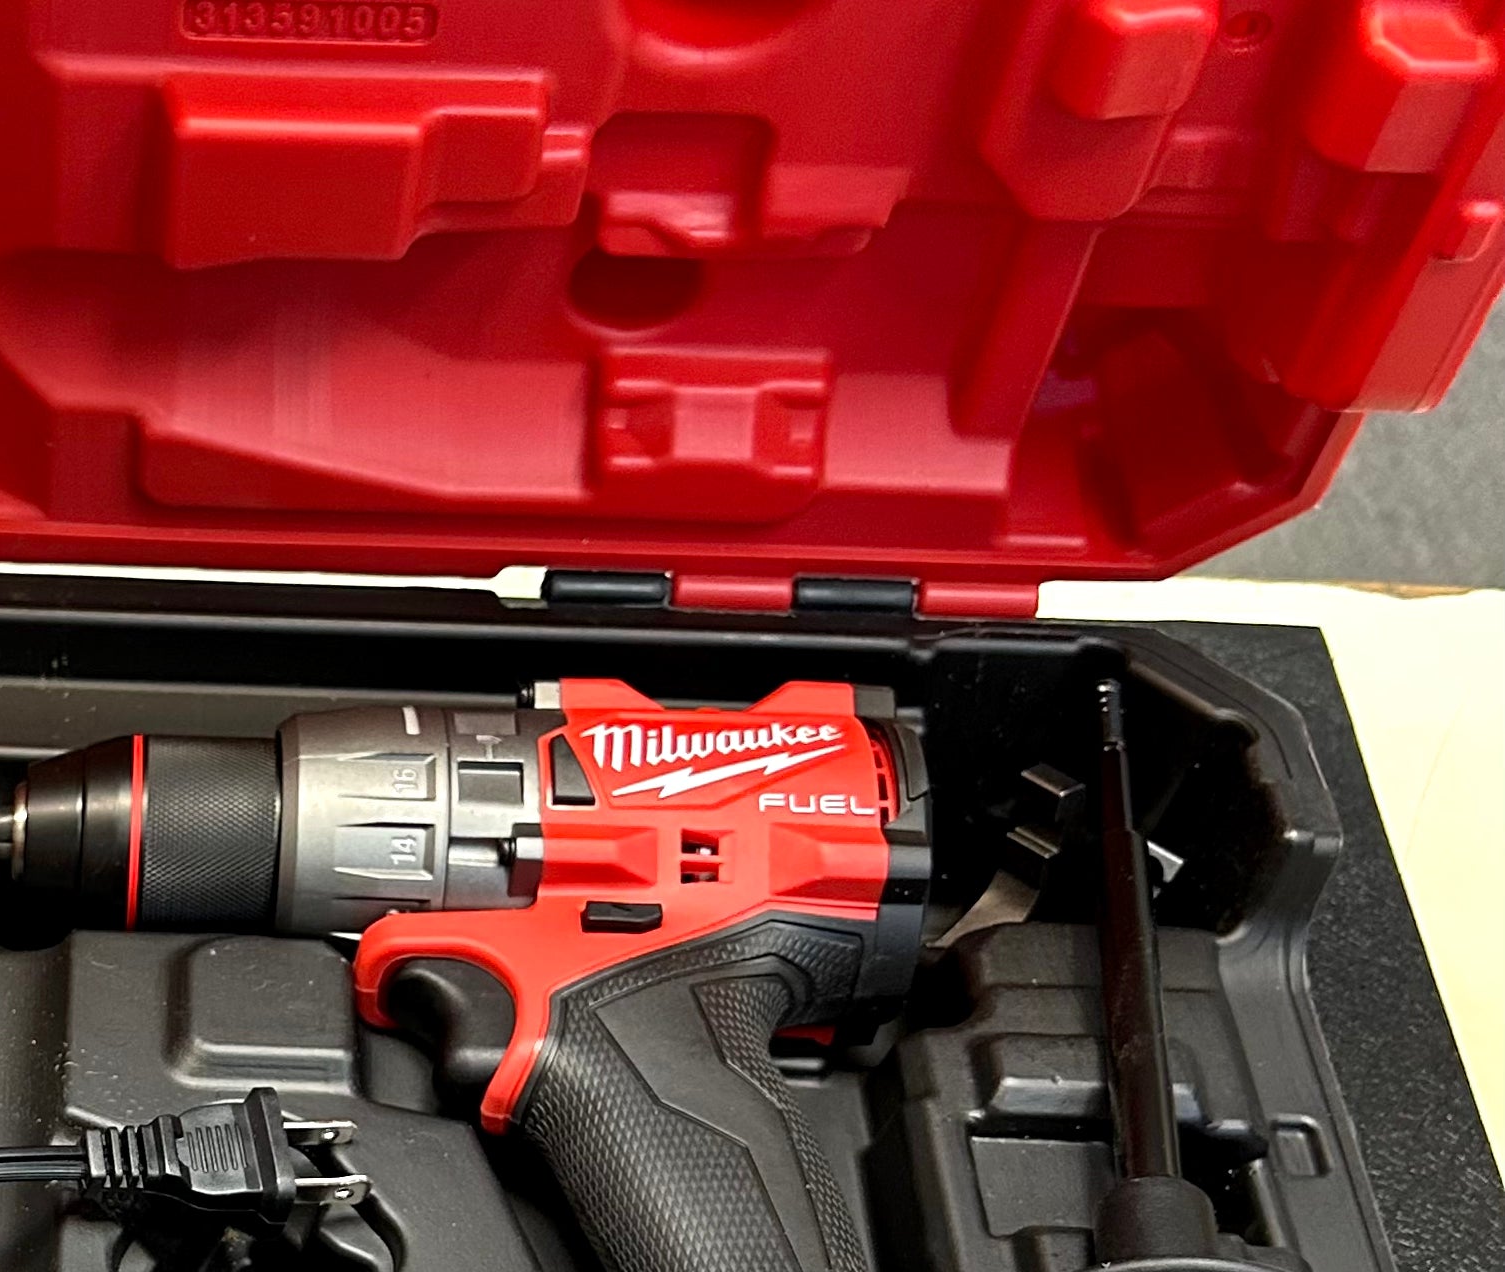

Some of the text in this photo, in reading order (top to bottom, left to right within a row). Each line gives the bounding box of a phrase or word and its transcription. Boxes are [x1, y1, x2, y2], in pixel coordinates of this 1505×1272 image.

[195, 1, 427, 36] 313591005
[580, 721, 845, 772] Milwaukee
[393, 767, 417, 794] 16
[758, 791, 876, 817] FUEL
[389, 835, 418, 866] 14
